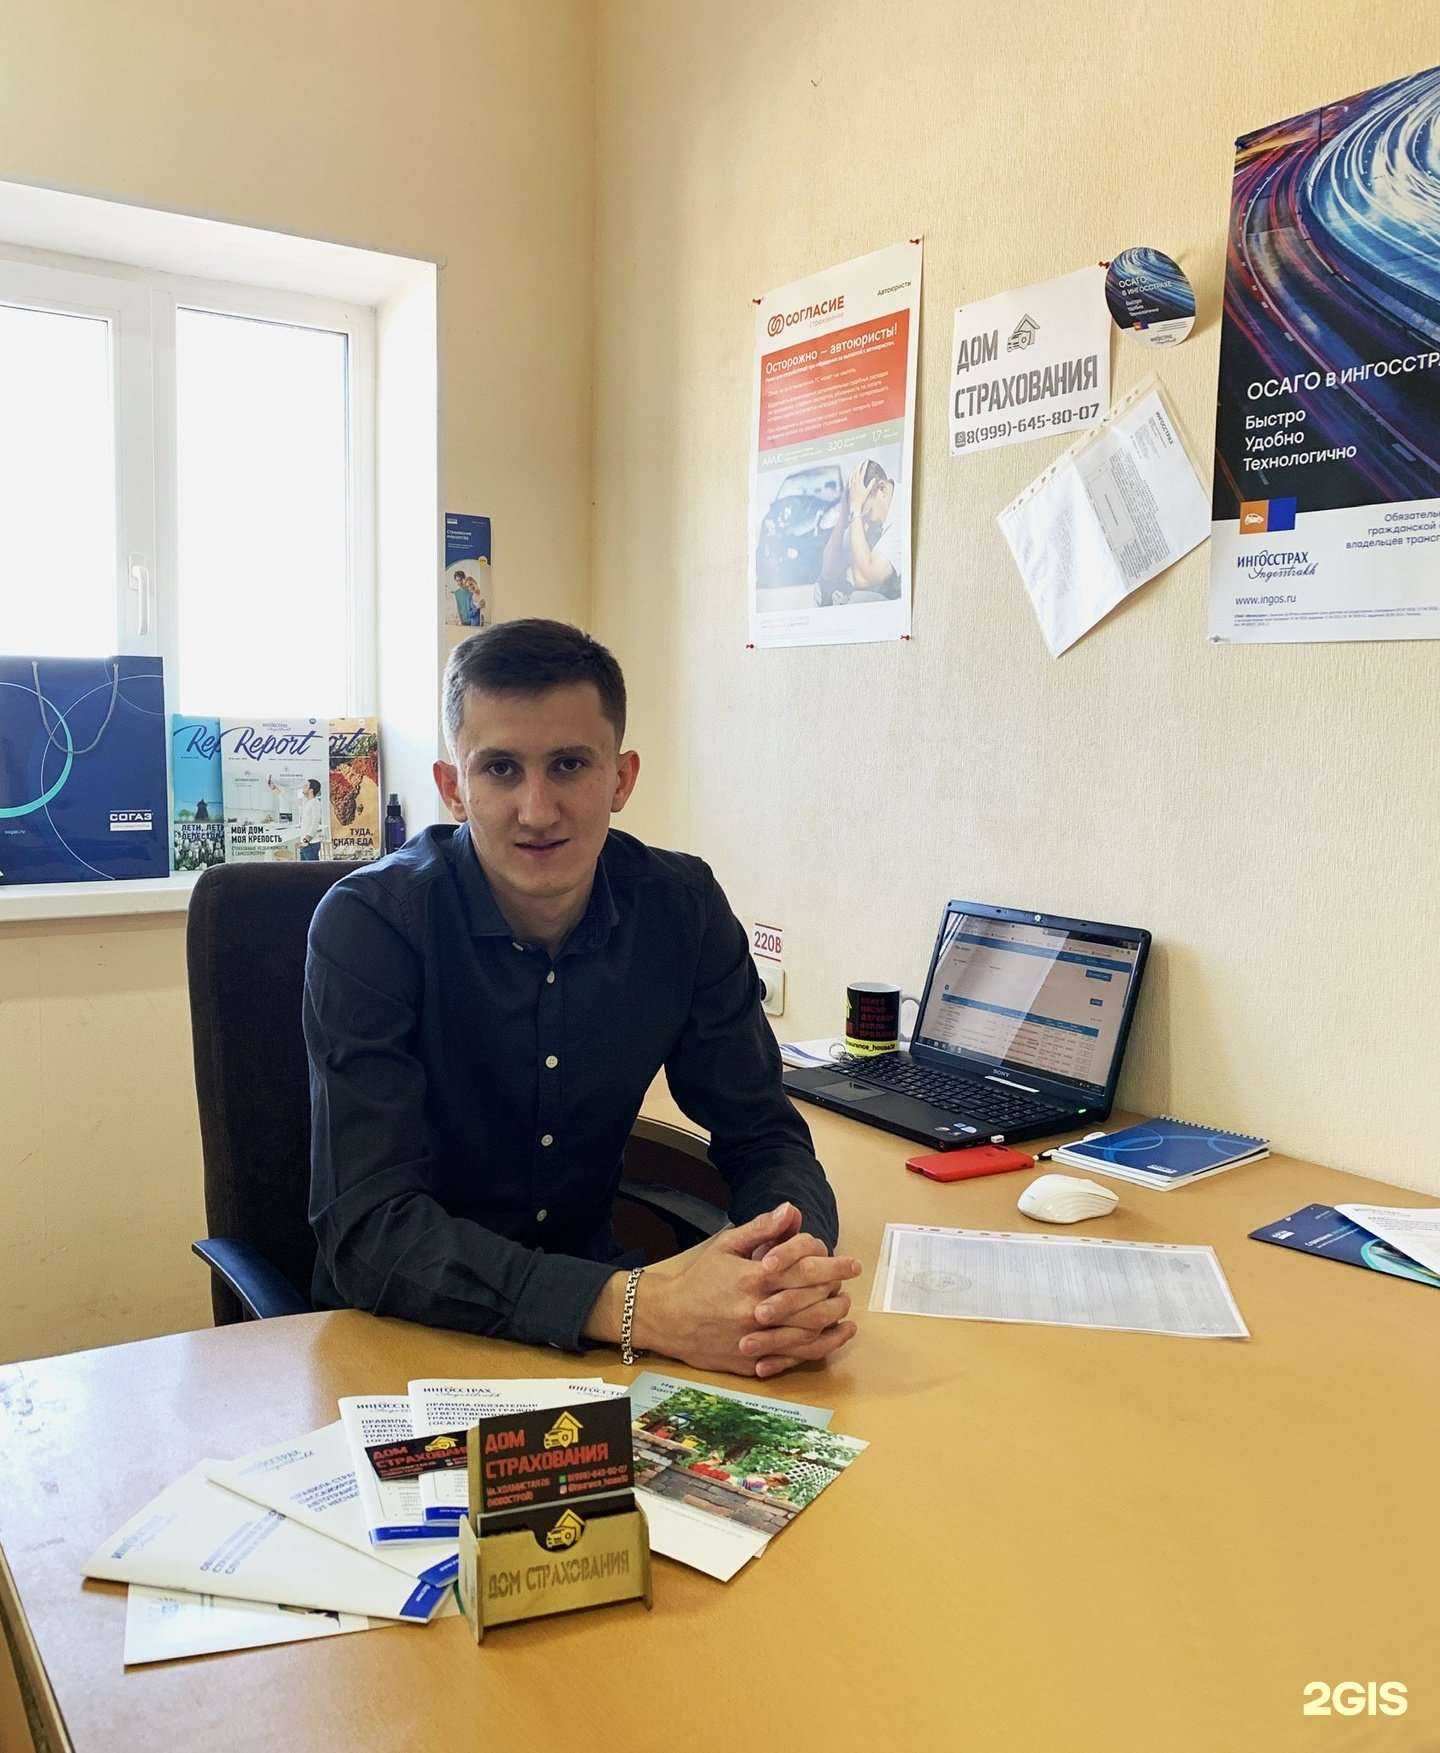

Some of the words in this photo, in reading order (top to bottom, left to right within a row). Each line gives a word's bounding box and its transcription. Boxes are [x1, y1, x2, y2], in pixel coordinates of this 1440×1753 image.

[786, 296, 845, 327] СОГЛАСИЕ
[766, 351, 818, 374] Осторожно
[830, 323, 898, 354] автоюристы!
[957, 329, 999, 375] ДОМ
[954, 355, 1098, 419] СТРАХОВАНИЯ
[1247, 372, 1321, 400] ОСАГО
[1325, 372, 1336, 387] в
[1341, 352, 1440, 386] ИНГОССТР
[967, 403, 1100, 444] 8(999)-645-80-07
[1245, 410, 1306, 430] Быстро
[1244, 431, 1305, 453] Удобно
[1243, 445, 1357, 472] Технологично
[1384, 511, 1440, 522] Обязатель
[1368, 521, 1436, 537] гражданской
[1346, 537, 1403, 549] владельцев
[1238, 550, 1309, 568] ИНГОССТРАХ
[1235, 594, 1297, 607] www.ingos.ru
[221, 725, 323, 761] Report
[109, 812, 153, 822] СОГАЗ
[231, 826, 247, 835] МОЙ
[248, 826, 264, 835] ДОМ
[231, 835, 247, 844] МОЯ
[248, 835, 283, 844] КРЕПОСТЬ
[754, 931, 782, 954] 220В
[484, 1429, 526, 1455] ДОМ
[485, 1443, 609, 1479] СТРАХОВАНИЯ
[488, 1567, 521, 1600] ДОМ
[526, 1550, 630, 1592] СТРАХОВАНИЯ
